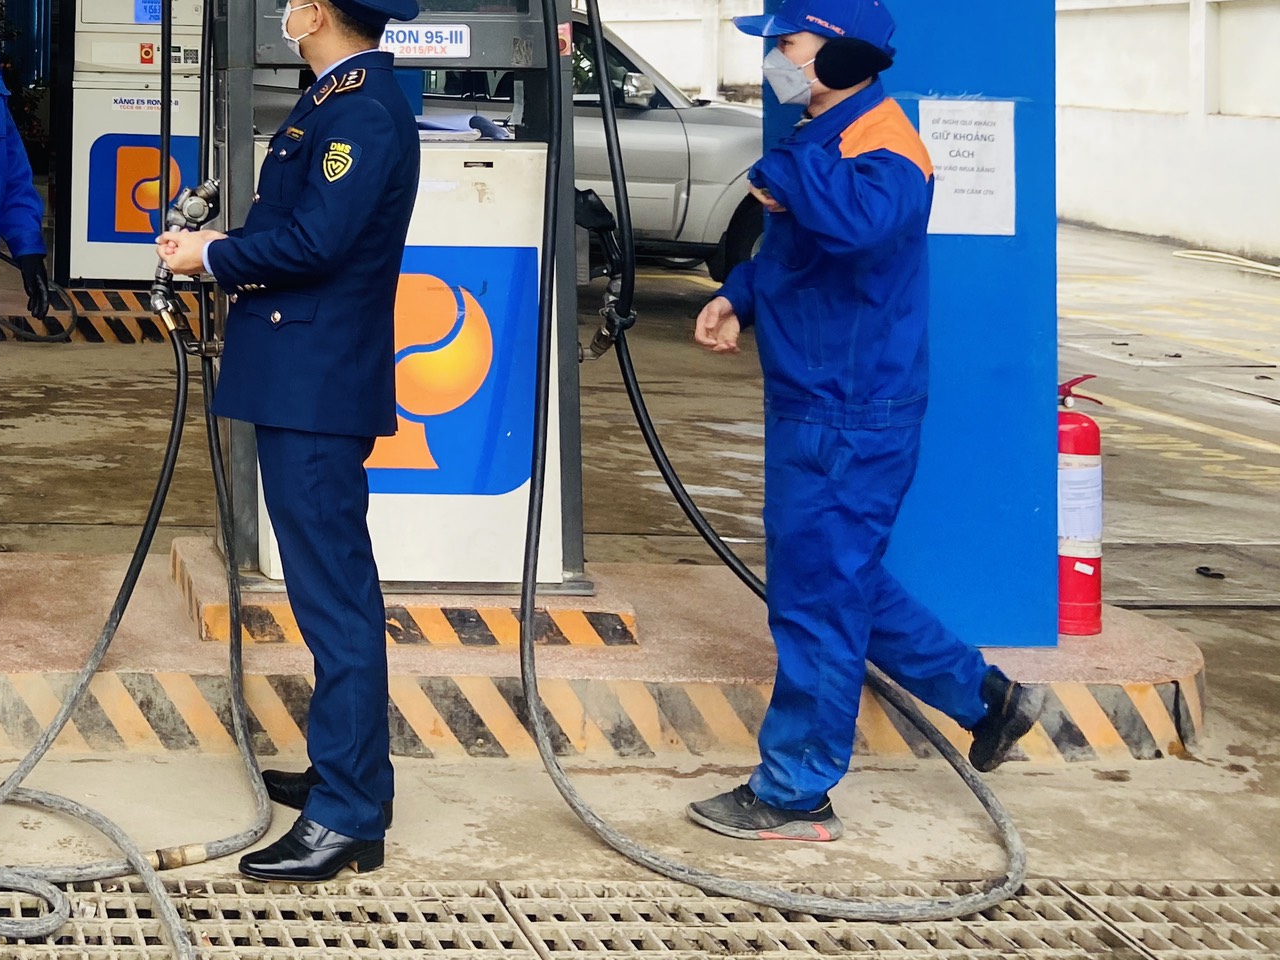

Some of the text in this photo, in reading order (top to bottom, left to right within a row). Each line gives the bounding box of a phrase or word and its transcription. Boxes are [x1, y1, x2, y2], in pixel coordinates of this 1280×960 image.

[385, 29, 464, 44] RON 95-III
[399, 46, 447, 55] 2015/PLX
[931, 131, 995, 142] GIỮ KHOẢNG
[330, 142, 352, 154] DMS
[948, 149, 975, 158] CÁCH
